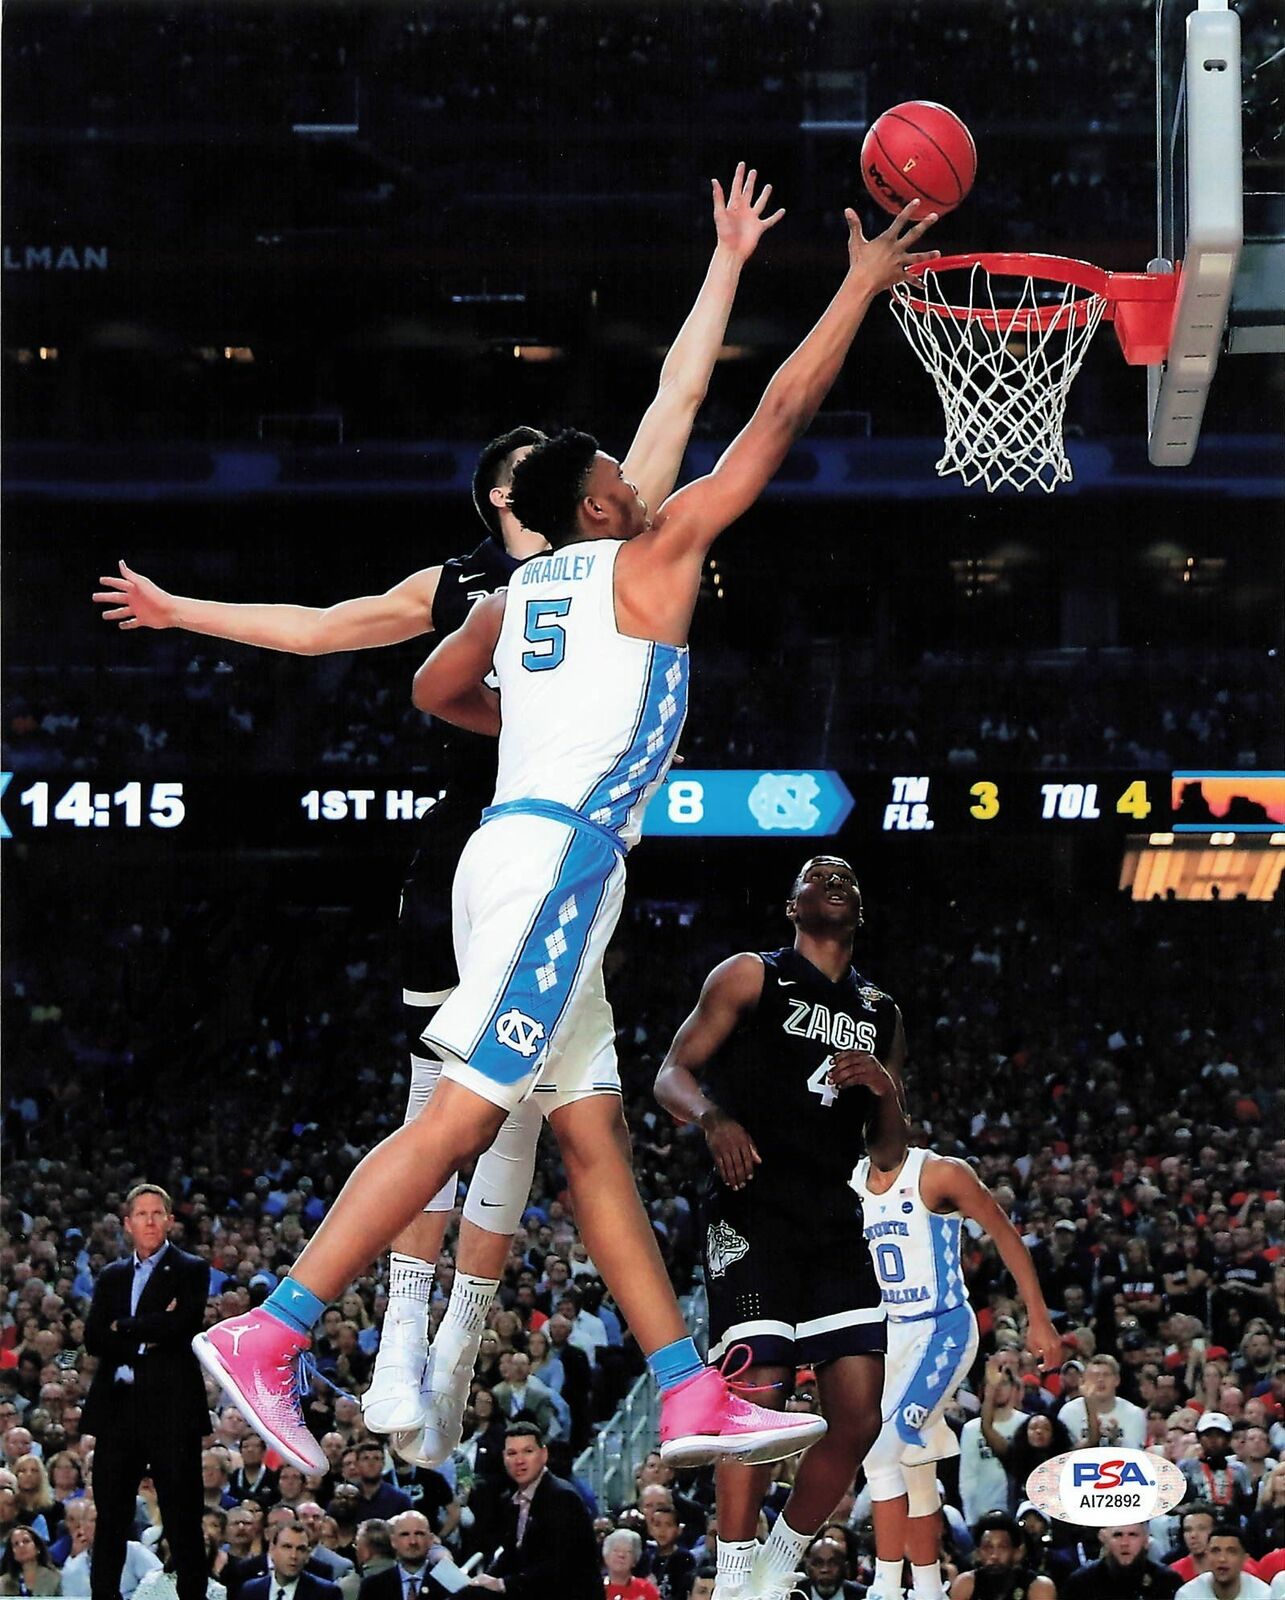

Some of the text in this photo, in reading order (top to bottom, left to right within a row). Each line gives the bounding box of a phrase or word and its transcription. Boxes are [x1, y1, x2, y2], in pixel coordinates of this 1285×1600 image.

[3, 246, 108, 270] LMAN
[522, 555, 596, 585] BRADLEY
[522, 597, 572, 672] 5
[20, 782, 185, 828] 14:15
[301, 789, 376, 820] 1ST
[668, 781, 704, 823] 8
[891, 776, 930, 802] TM
[970, 781, 1000, 820] 3
[1040, 780, 1152, 819] TOL 4
[883, 803, 935, 831] FLS.
[782, 998, 877, 1053] ZAGS
[806, 1054, 839, 1107] 4
[876, 1243, 905, 1283] 0
